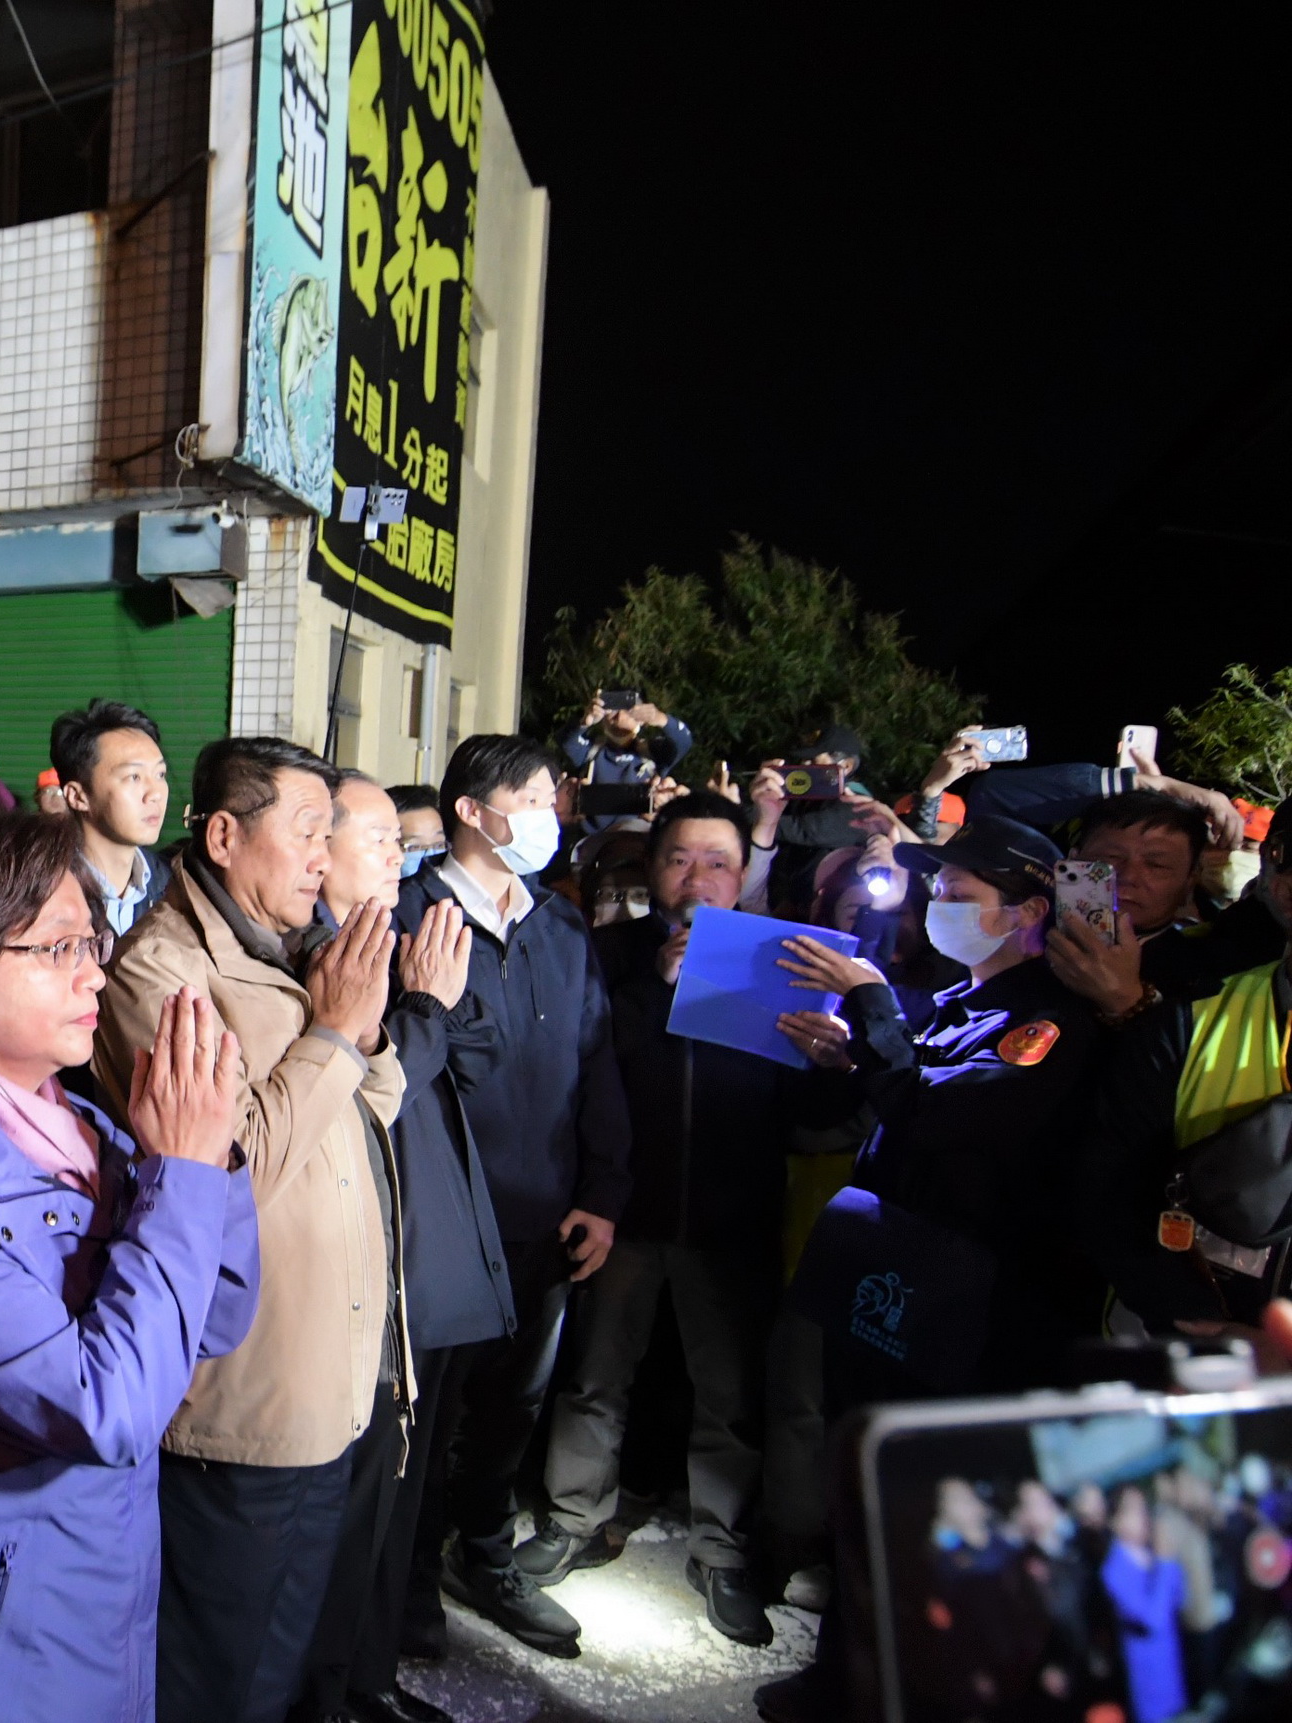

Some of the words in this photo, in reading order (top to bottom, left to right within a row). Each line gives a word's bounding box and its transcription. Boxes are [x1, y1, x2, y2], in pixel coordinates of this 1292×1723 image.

[384, 0, 483, 173] 00505
[345, 354, 449, 506] 月息1分起
[368, 512, 455, 593] 胎廠房
